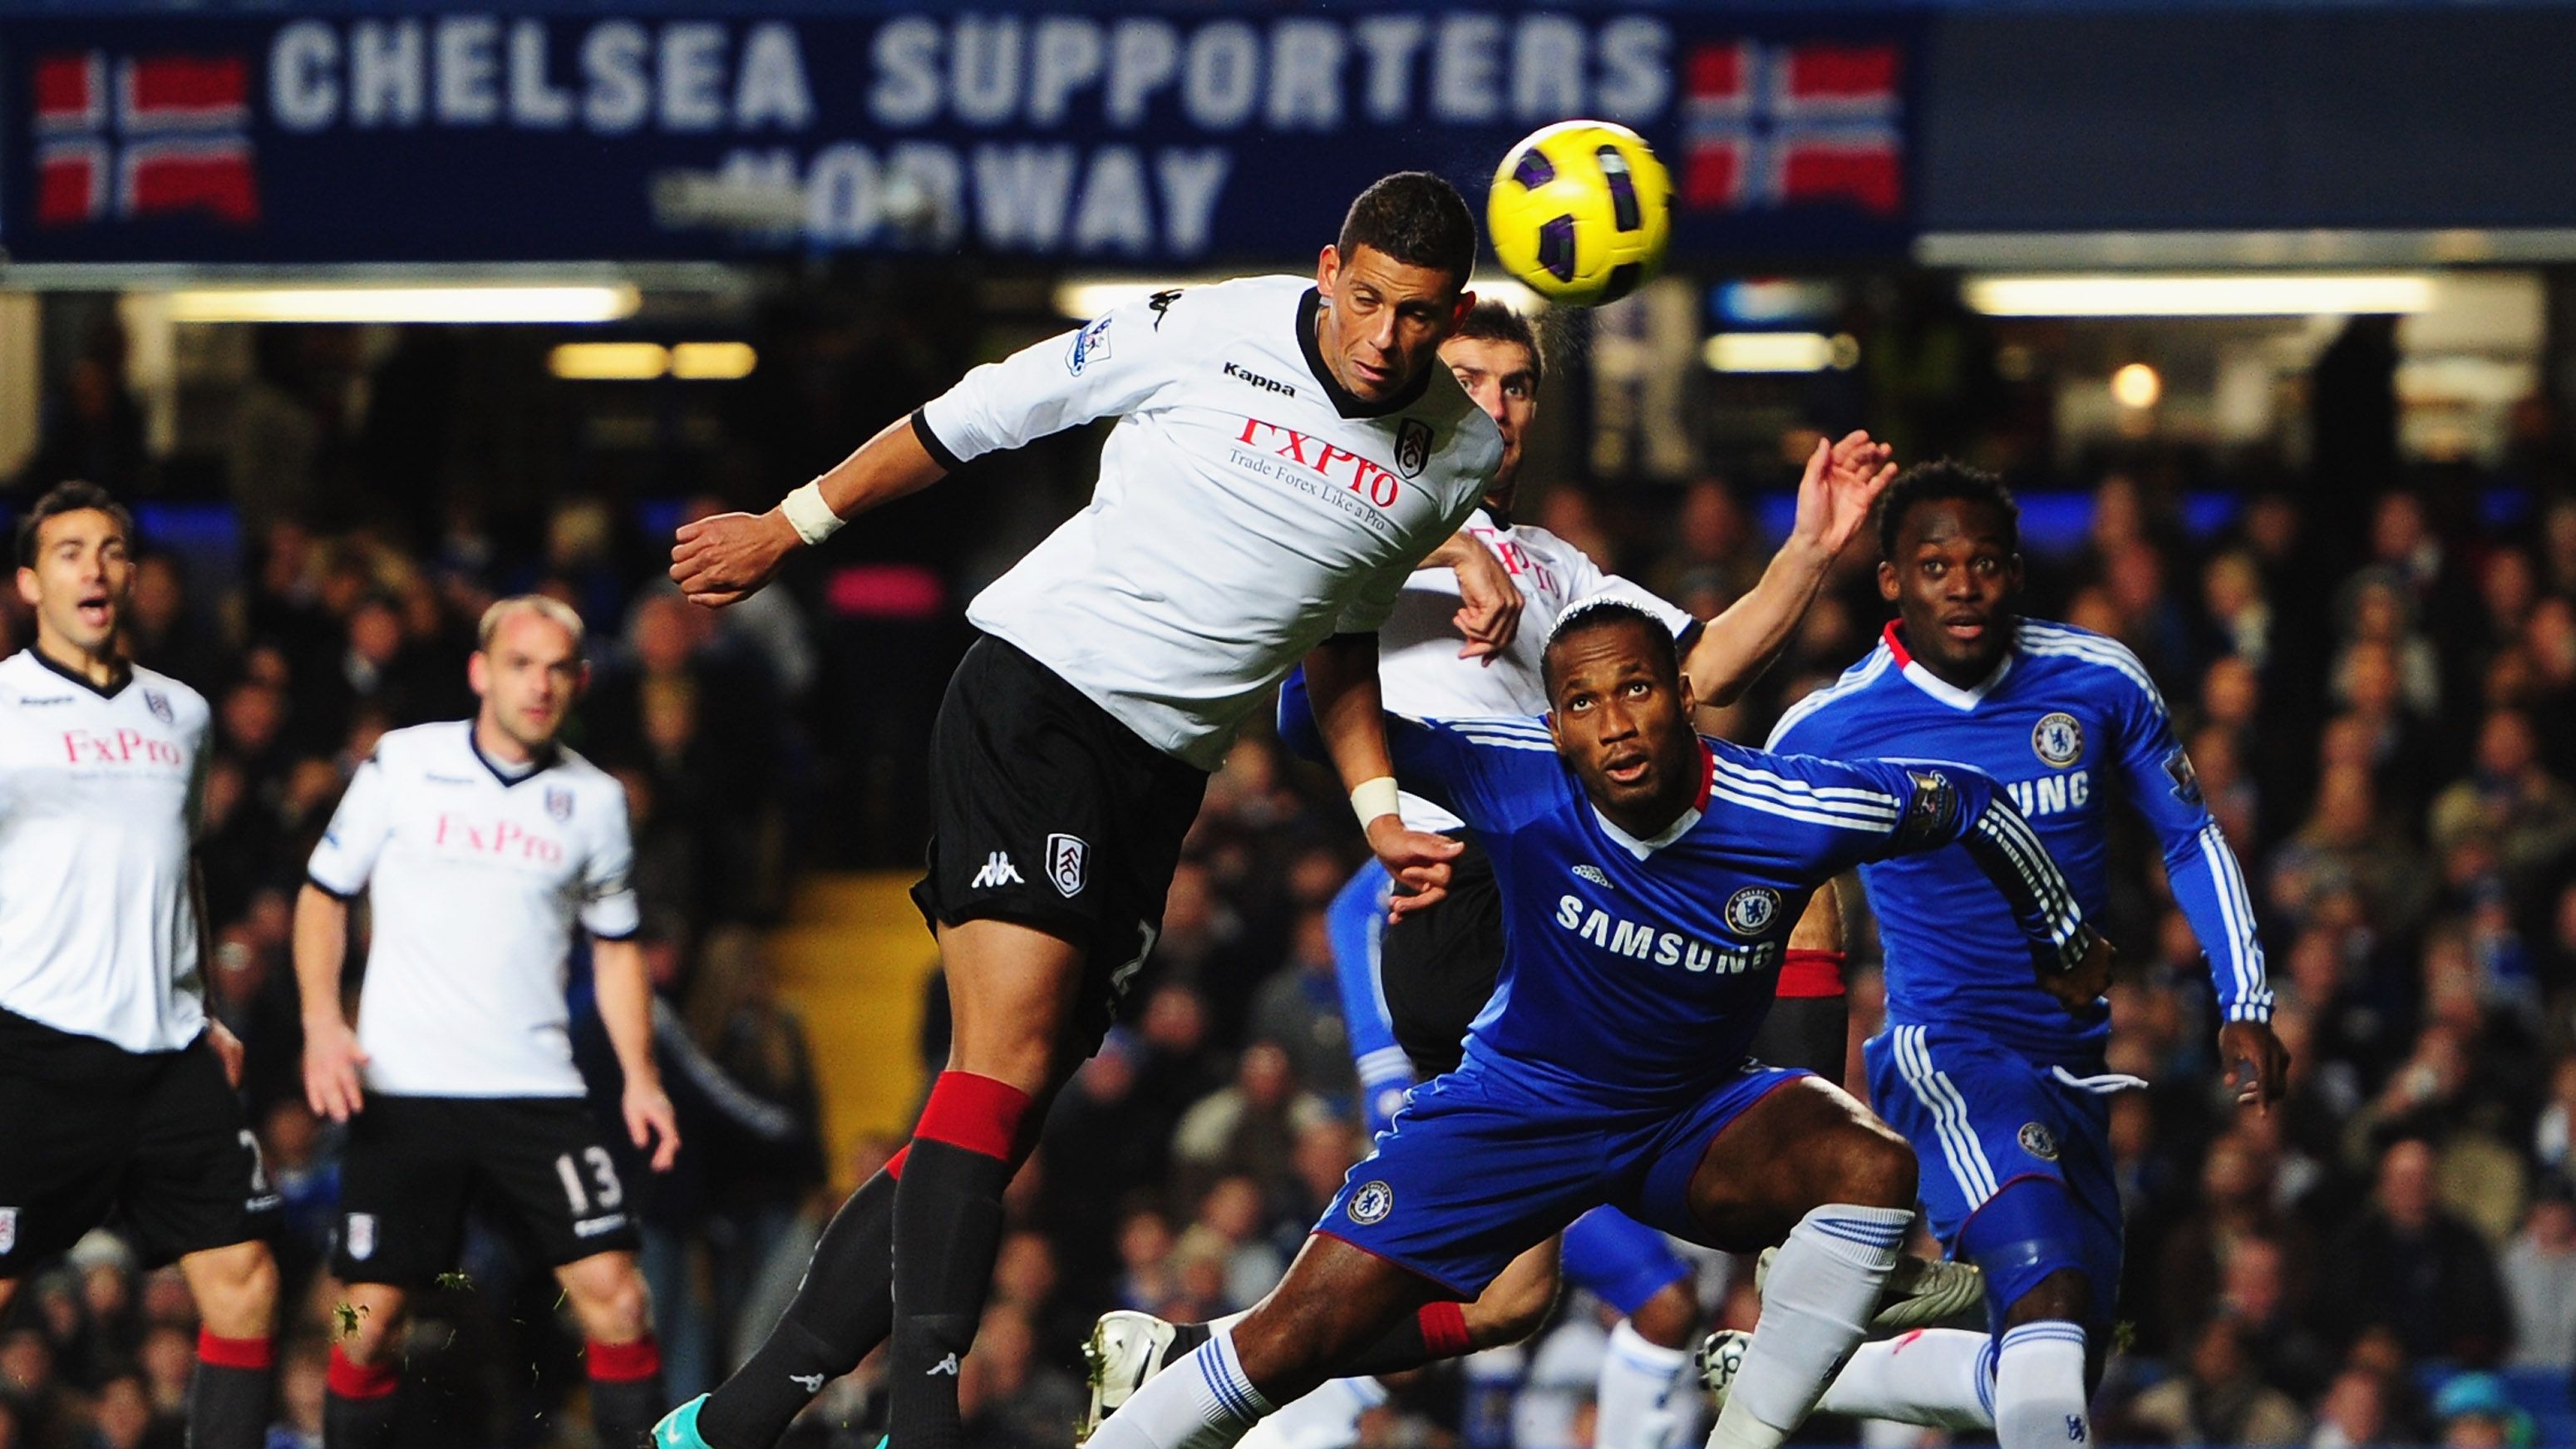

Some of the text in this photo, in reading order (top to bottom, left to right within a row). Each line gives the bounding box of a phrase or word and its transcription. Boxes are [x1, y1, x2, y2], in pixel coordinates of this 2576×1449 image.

[268, 15, 1671, 131] CHELSEA SUPPORTERS
[1224, 362, 1296, 398] Kappa
[1230, 448, 1386, 531] Trade Forex Like a Pro
[63, 728, 180, 765] FxPro
[1556, 895, 1776, 974] SAMSUNG
[555, 1146, 623, 1214] 13
